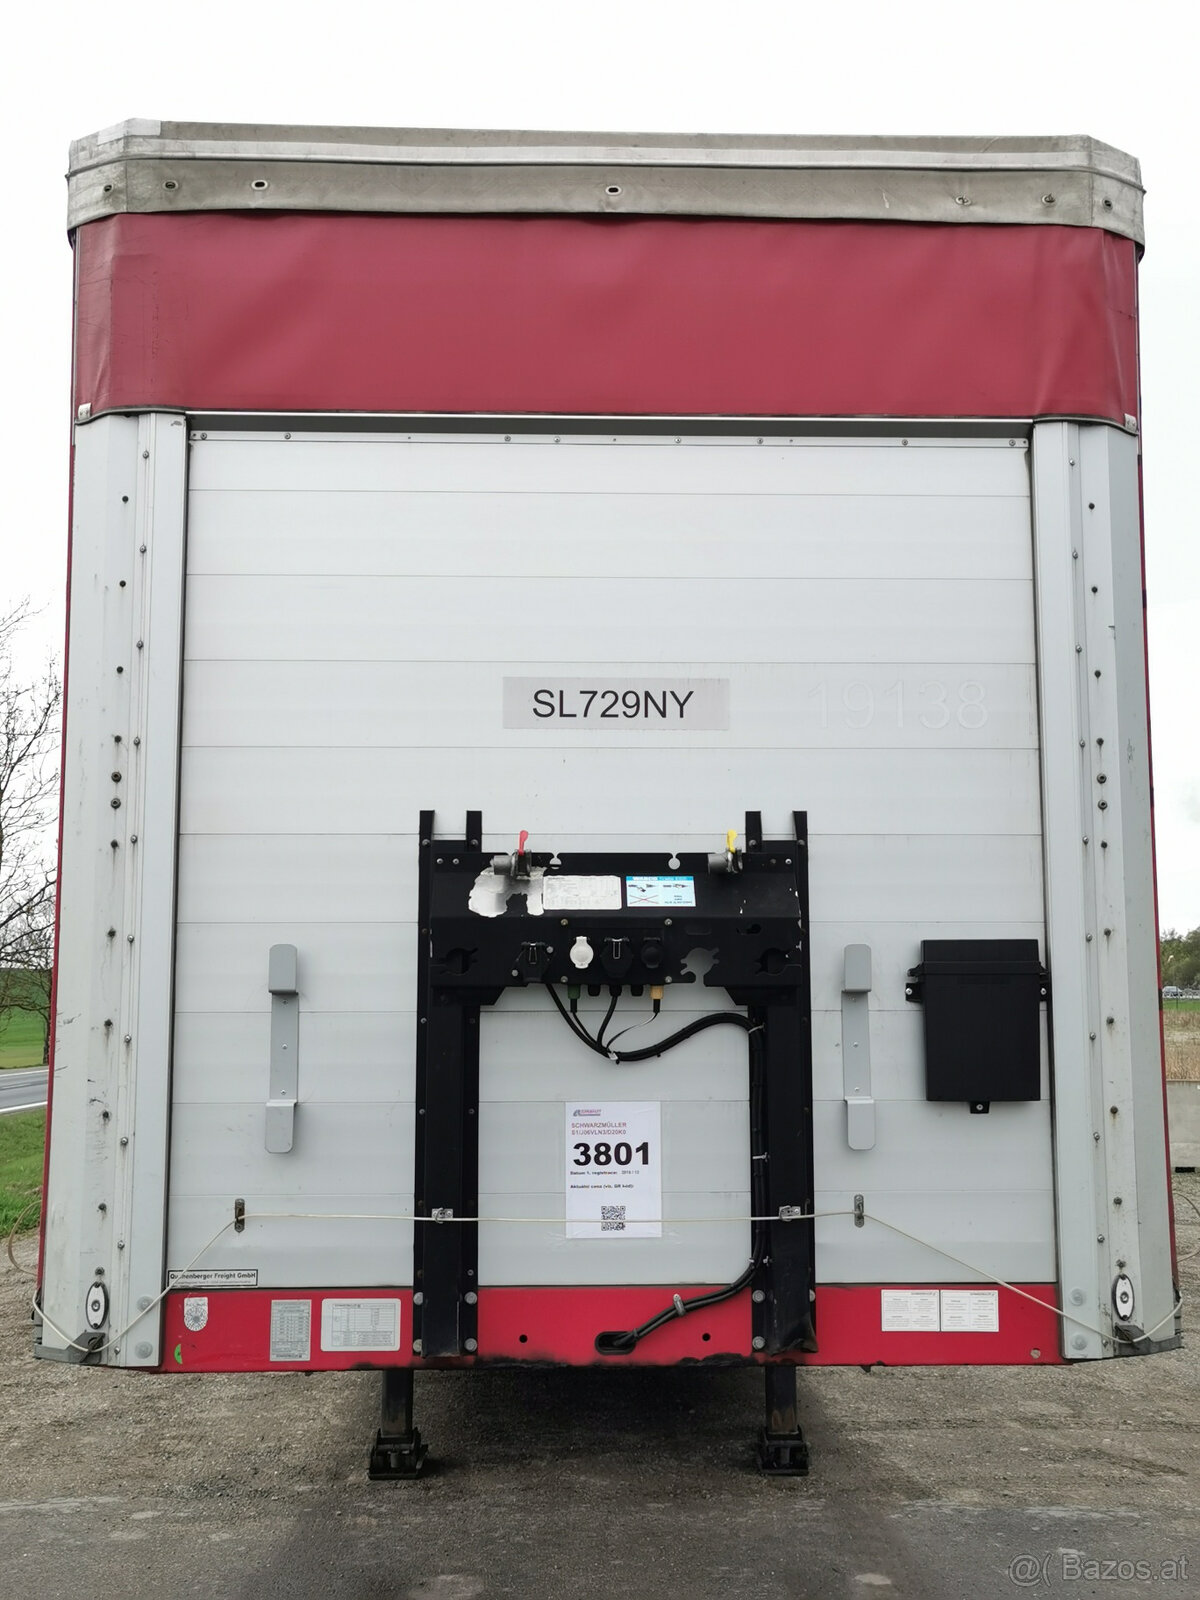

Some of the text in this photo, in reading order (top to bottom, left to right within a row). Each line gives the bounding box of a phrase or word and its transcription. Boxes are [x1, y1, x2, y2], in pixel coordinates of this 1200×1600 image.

[532, 690, 694, 719] SL729NY
[808, 680, 989, 730] 19138
[573, 1142, 649, 1166] 3801
[214, 1272, 236, 1280] Freight
